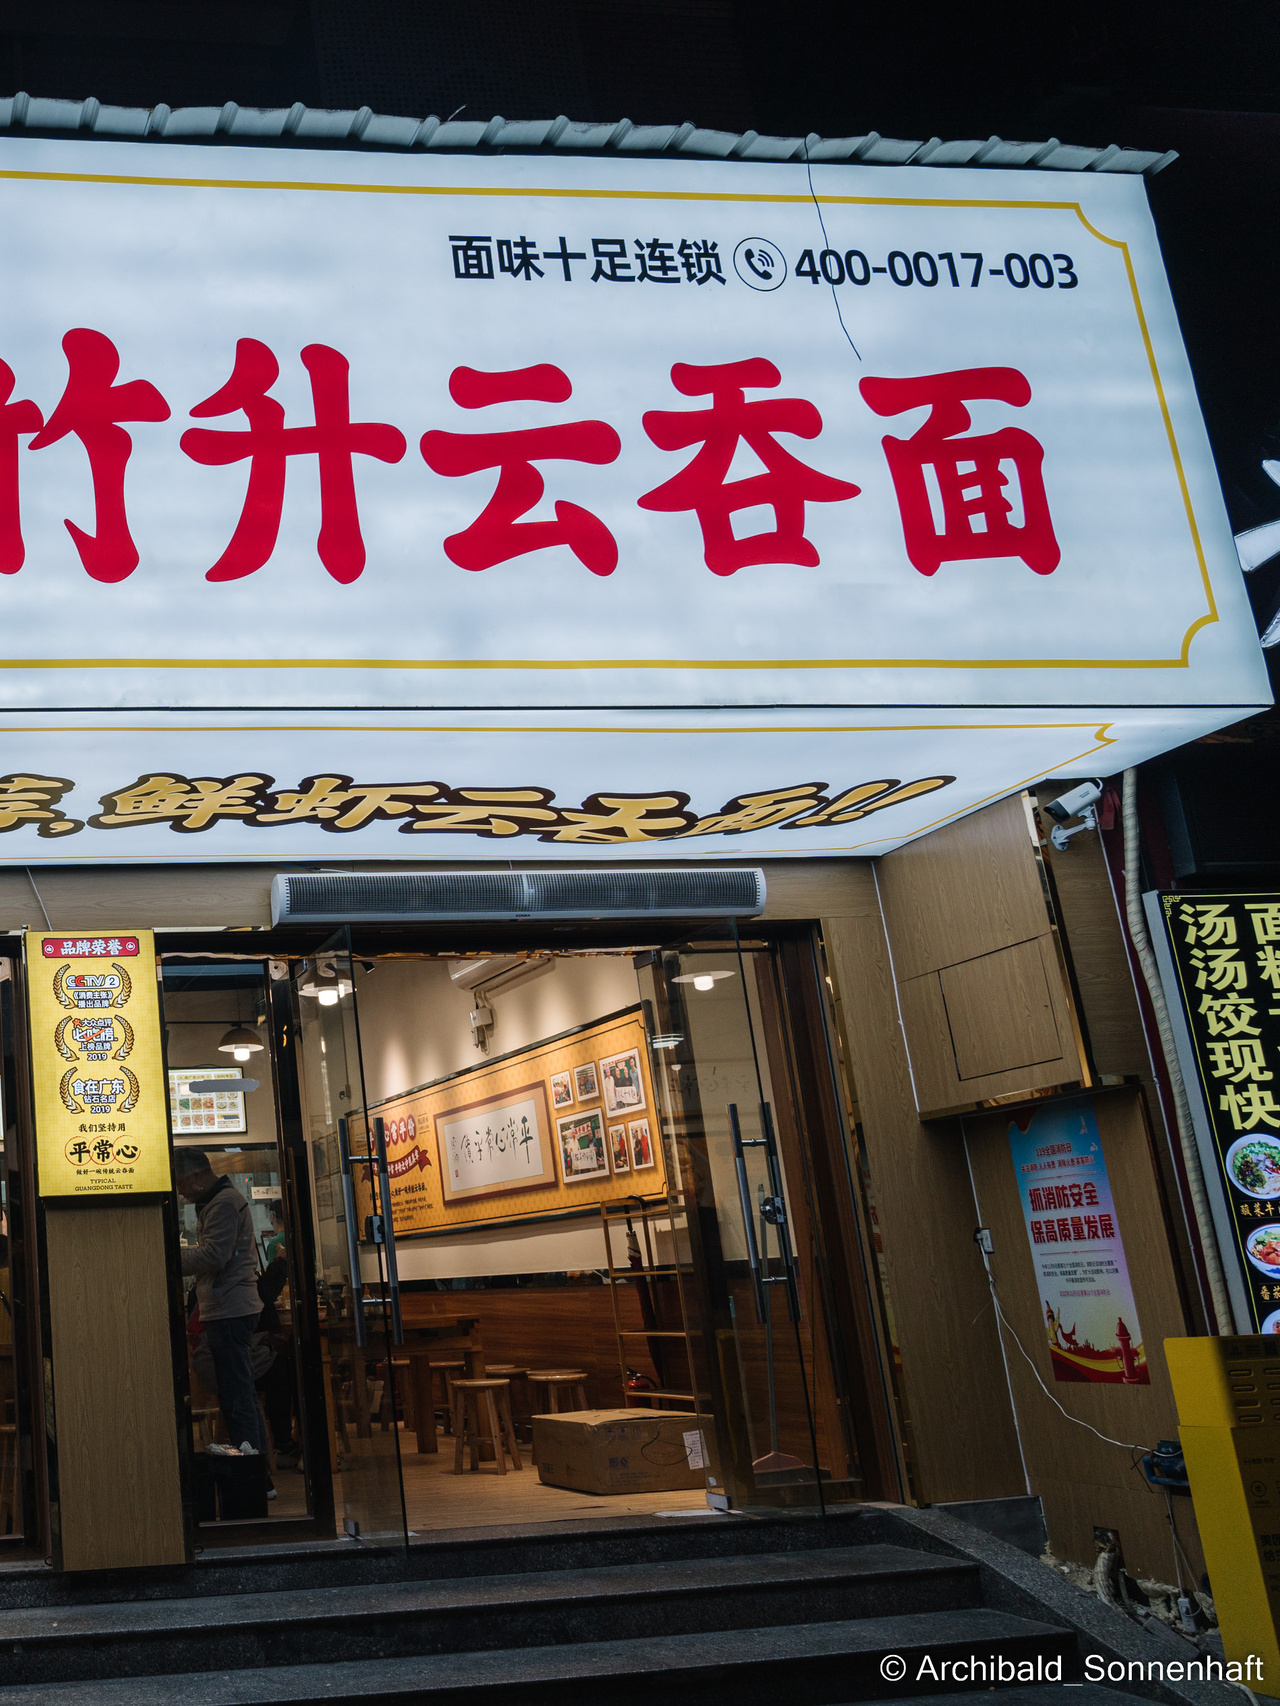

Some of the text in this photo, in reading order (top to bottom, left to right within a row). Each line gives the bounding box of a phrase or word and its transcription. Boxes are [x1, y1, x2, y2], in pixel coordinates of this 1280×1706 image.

[448, 233, 1080, 291] 面味十足连锁 400-0017-003
[60, 938, 123, 957] 品牌荣誉
[73, 990, 113, 1000] 《消费主张》
[78, 999, 110, 1009] 播出品牌
[82, 1018, 113, 1027] 大众点评
[79, 1042, 112, 1051] 上榜品牌
[87, 1053, 108, 1061] 2019
[72, 1078, 125, 1096] 食在广东
[83, 1095, 117, 1104] 钻石名店
[90, 1105, 111, 1113] 2019
[78, 1122, 126, 1133] 我们坚持用
[69, 1138, 139, 1163] 平常心
[74, 1184, 114, 1192] GUANGDONG
[1029, 1181, 1100, 1212] 抓消防安全
[1030, 1213, 1116, 1244] 保高质量发展
